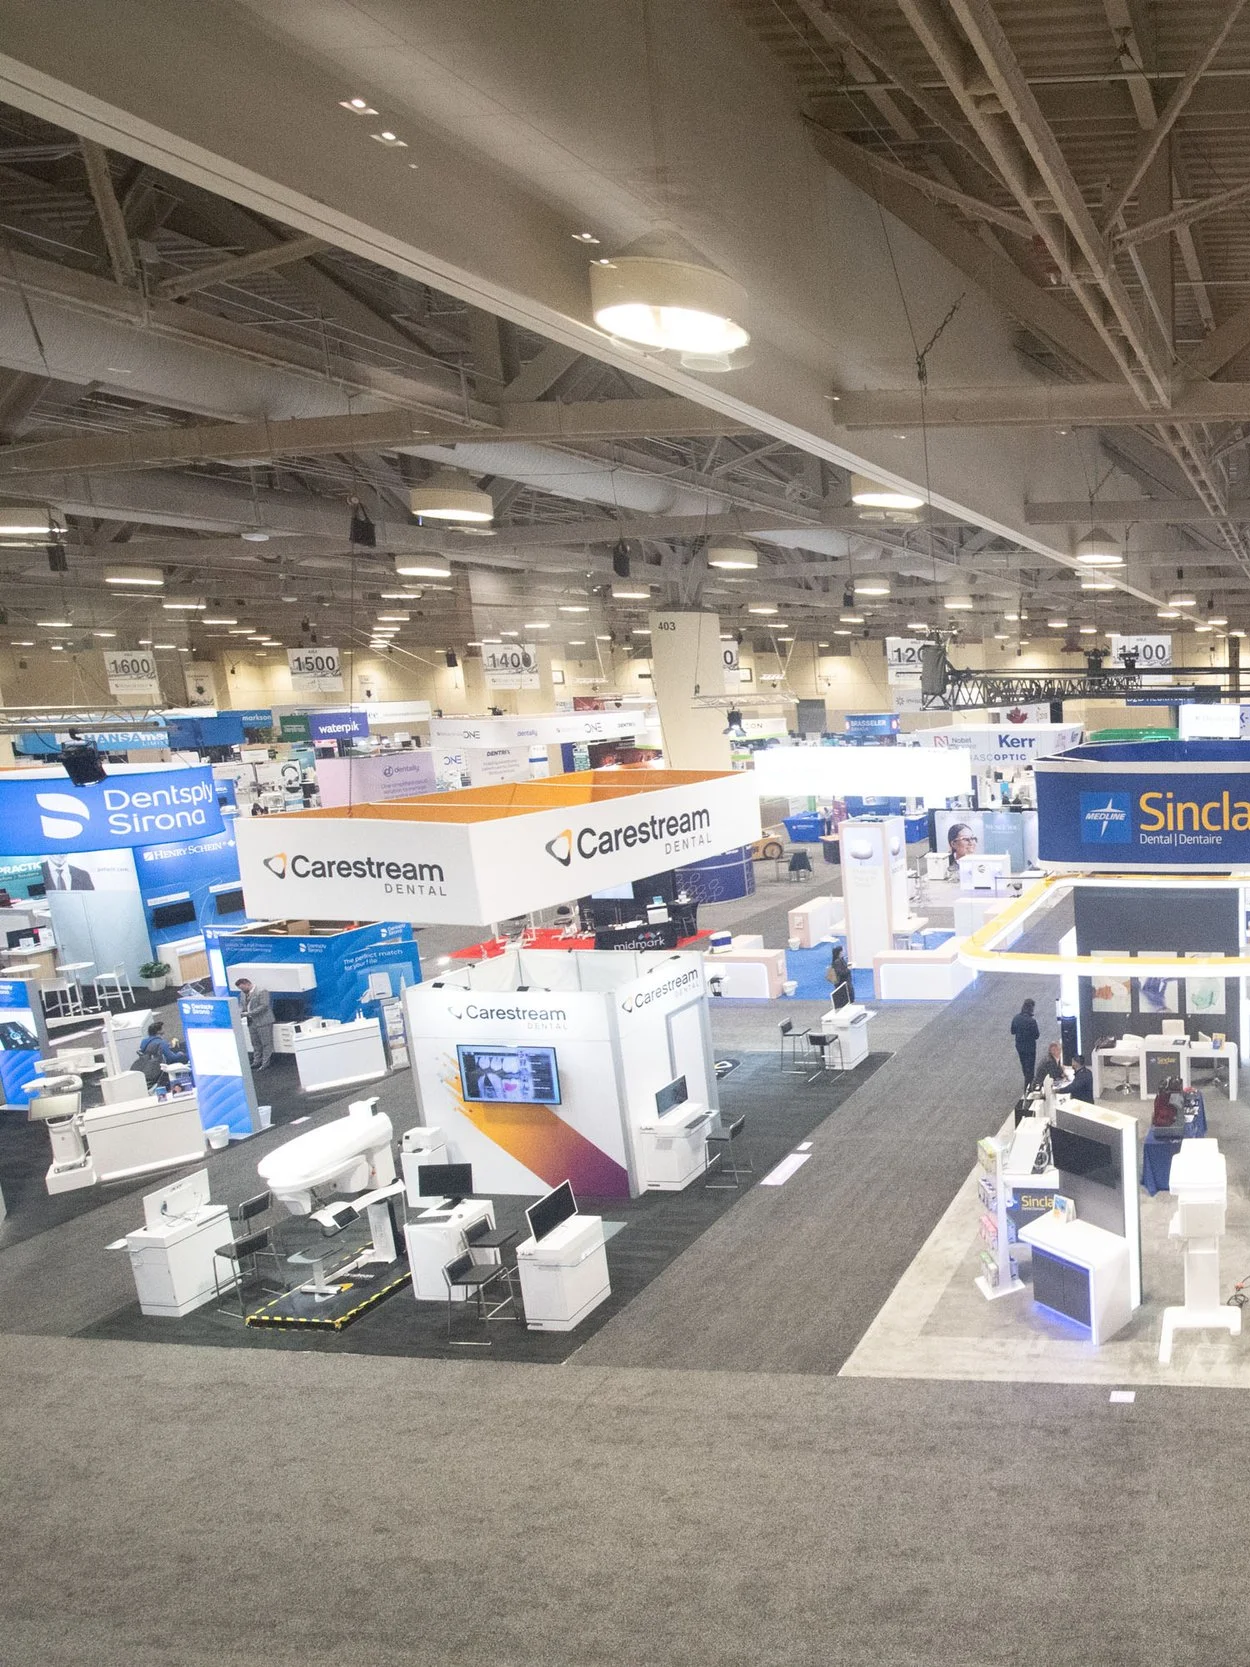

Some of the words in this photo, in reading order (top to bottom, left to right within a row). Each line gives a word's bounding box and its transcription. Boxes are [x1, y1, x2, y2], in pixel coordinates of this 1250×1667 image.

[658, 622, 676, 631] 403
[111, 659, 150, 675] 1600
[295, 656, 335, 672] 1500
[243, 711, 271, 721] markson
[318, 720, 360, 734] waterpik
[998, 734, 1036, 748] Kerr
[103, 781, 213, 810] Dentsply
[108, 809, 206, 835] Sirona
[1085, 812, 1127, 821] MEDLINE
[577, 808, 710, 859] Carestream
[153, 849, 188, 860] HENRY
[188, 842, 223, 854] SCHEIN
[665, 835, 712, 855] DENTAL
[291, 855, 444, 882] Carestream
[384, 883, 447, 896] DENTAL
[613, 937, 665, 951] midmark
[634, 968, 699, 1008] Carestream
[466, 1005, 567, 1021] Carestream
[527, 1022, 568, 1030] DENTAL
